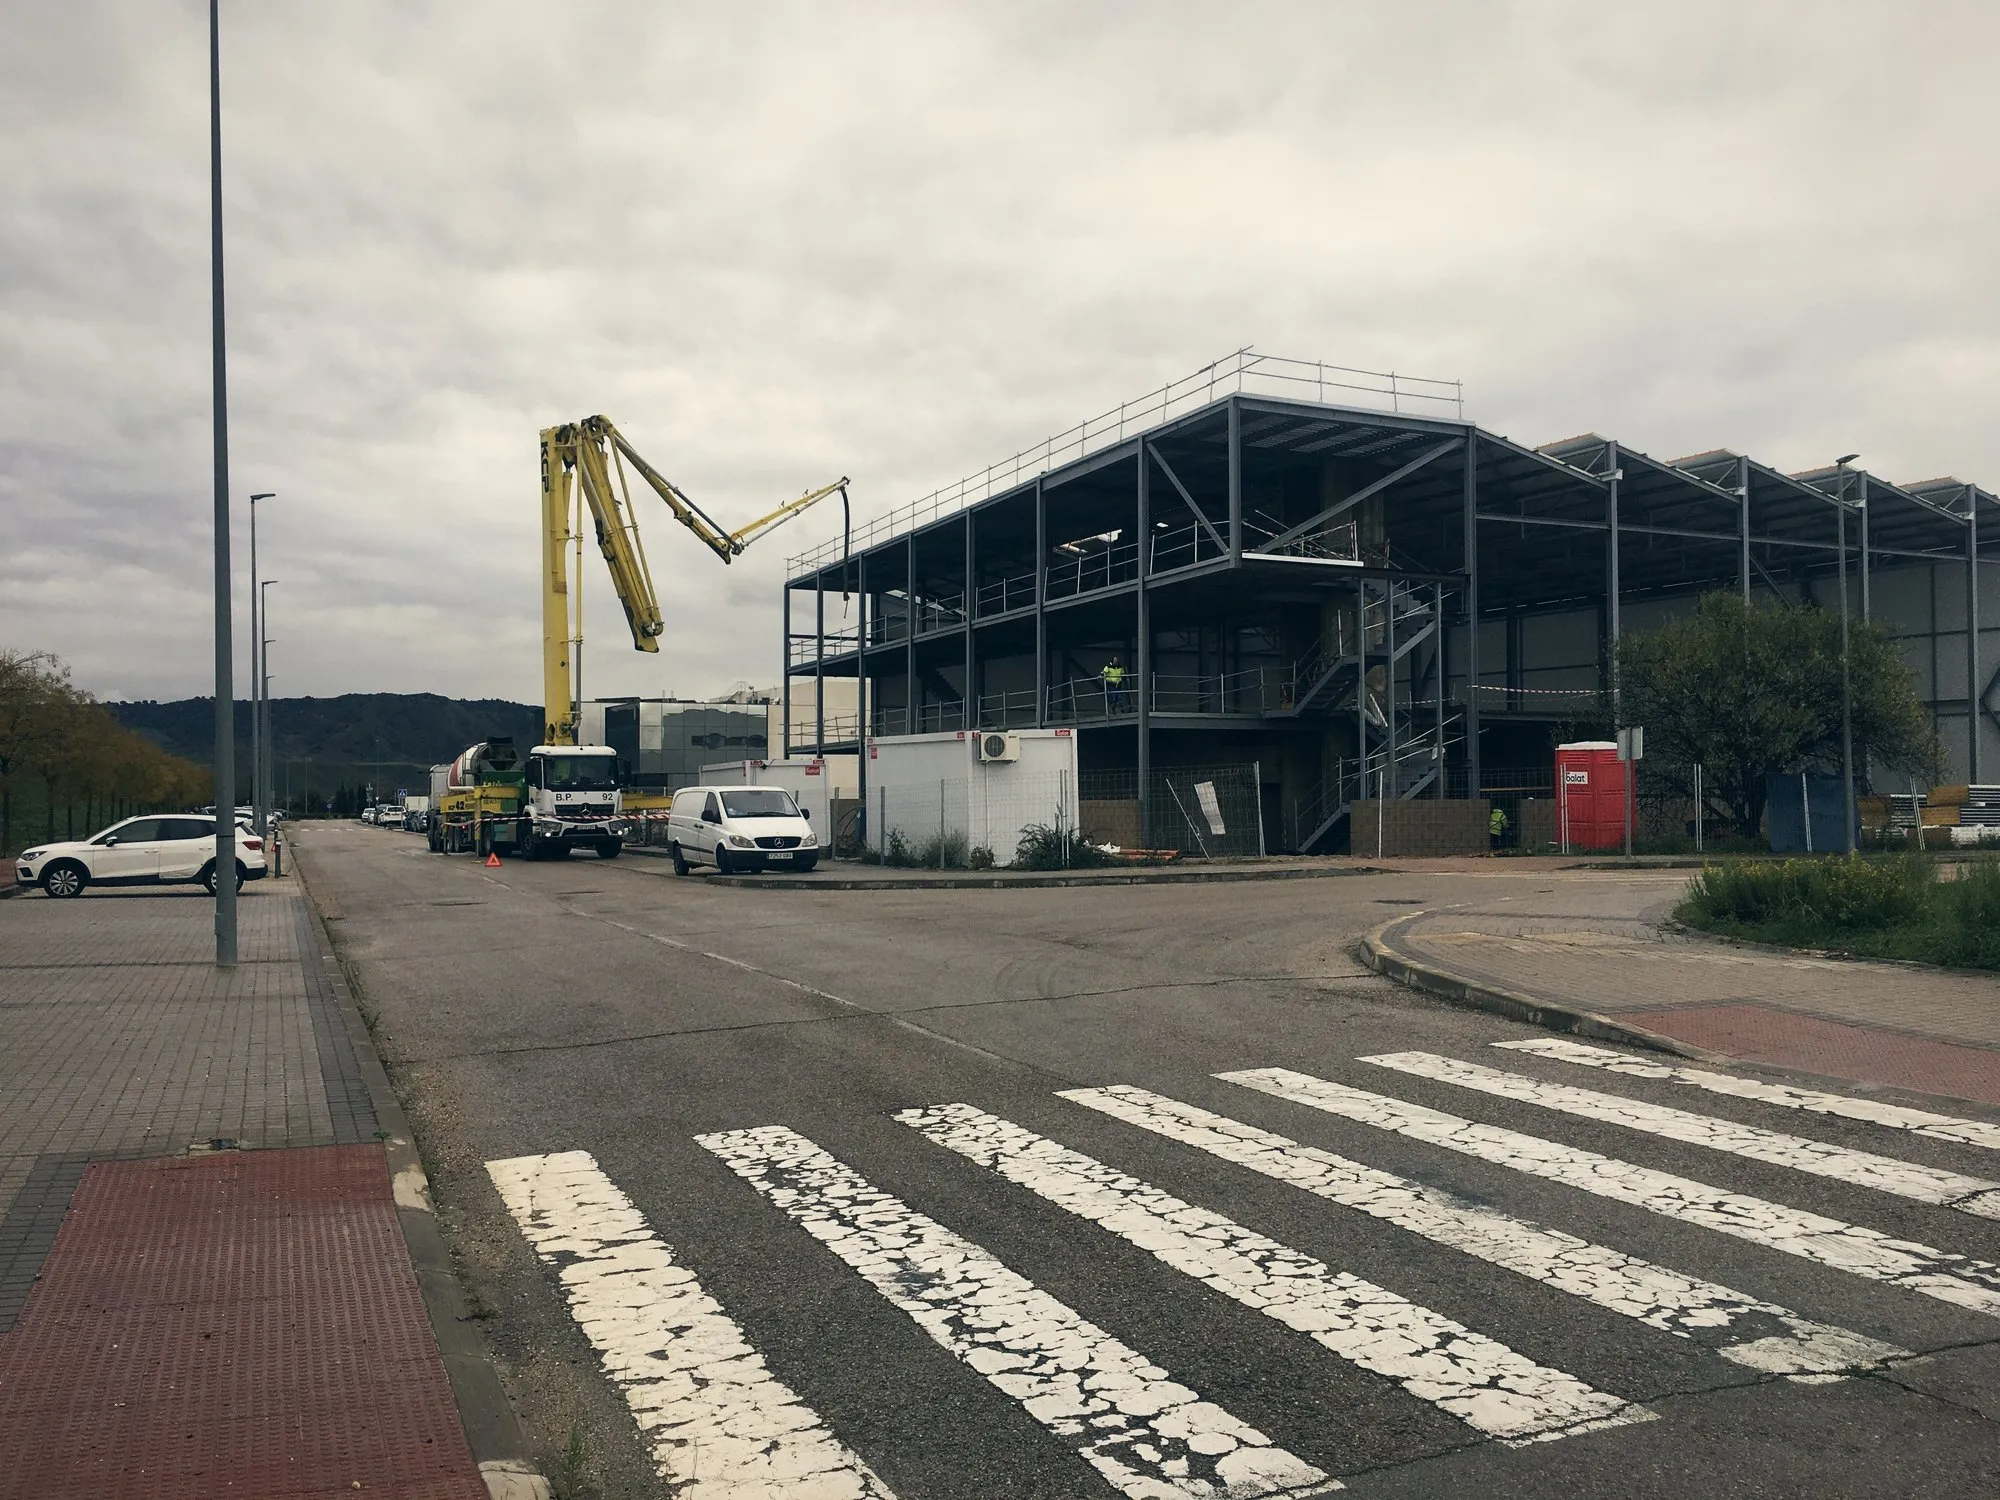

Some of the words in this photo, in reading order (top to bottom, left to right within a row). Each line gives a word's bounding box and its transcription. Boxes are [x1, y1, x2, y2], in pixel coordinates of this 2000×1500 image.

[541, 441, 549, 492] KCP
[556, 793, 573, 801] B.P.
[602, 793, 613, 801] 92
[456, 801, 465, 810] 42
